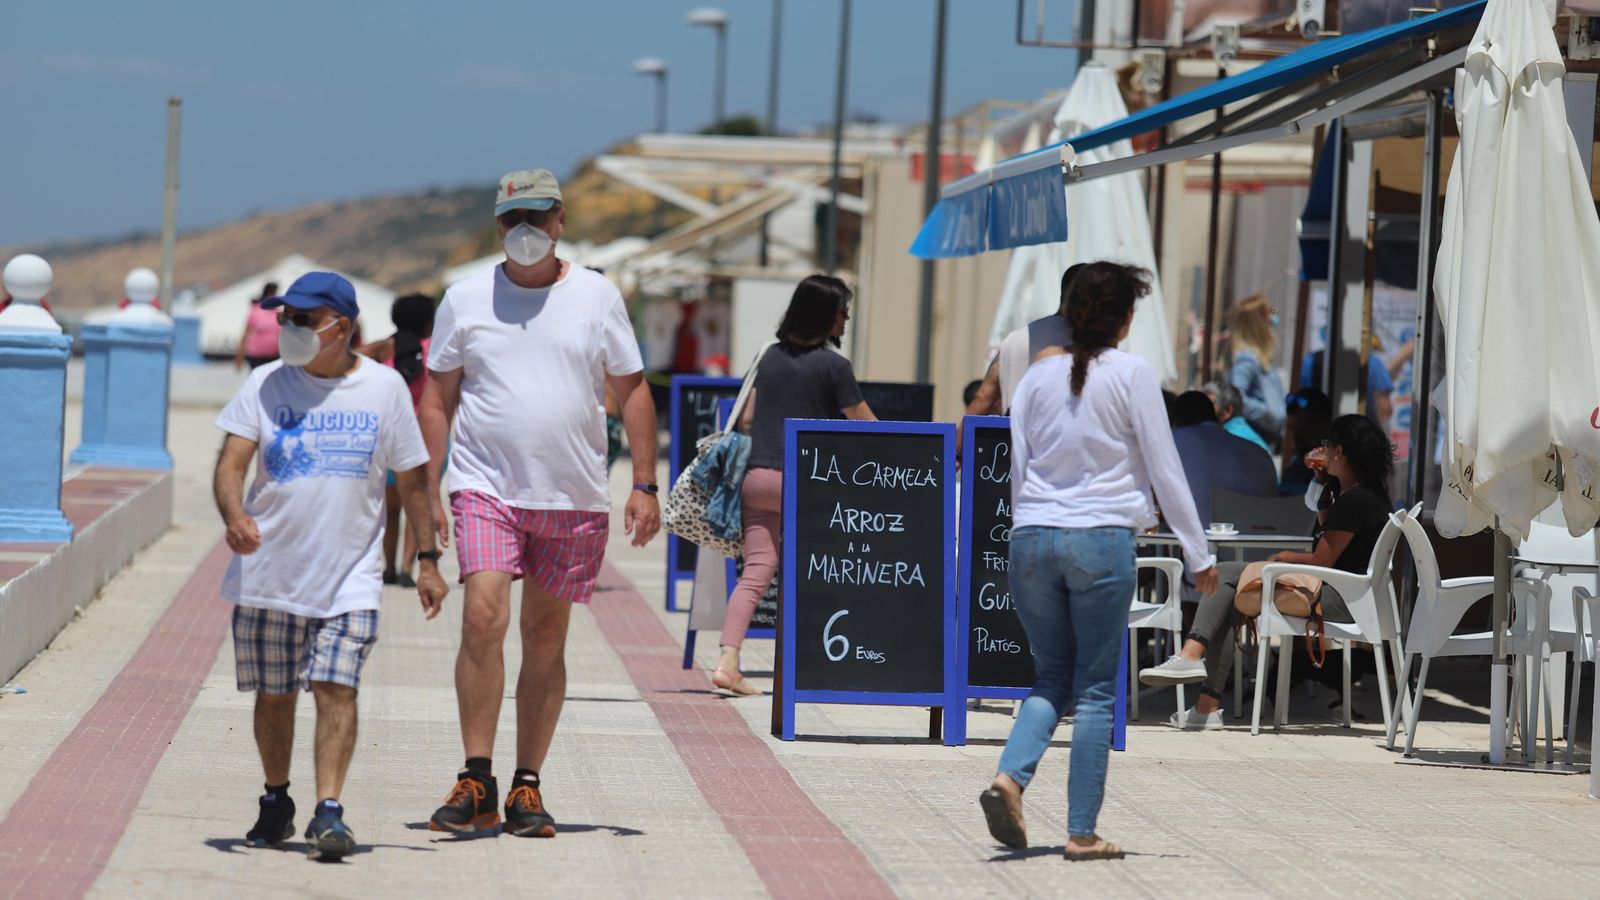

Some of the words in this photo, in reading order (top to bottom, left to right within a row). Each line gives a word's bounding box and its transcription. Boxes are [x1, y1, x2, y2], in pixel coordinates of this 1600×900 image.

[274, 405, 379, 432] DELICIOUS
[830, 502, 905, 533] ARROZ
[848, 542, 854, 553] A
[862, 543, 870, 552] LA
[823, 609, 850, 662] 6
[973, 626, 1021, 654] PLATOS
